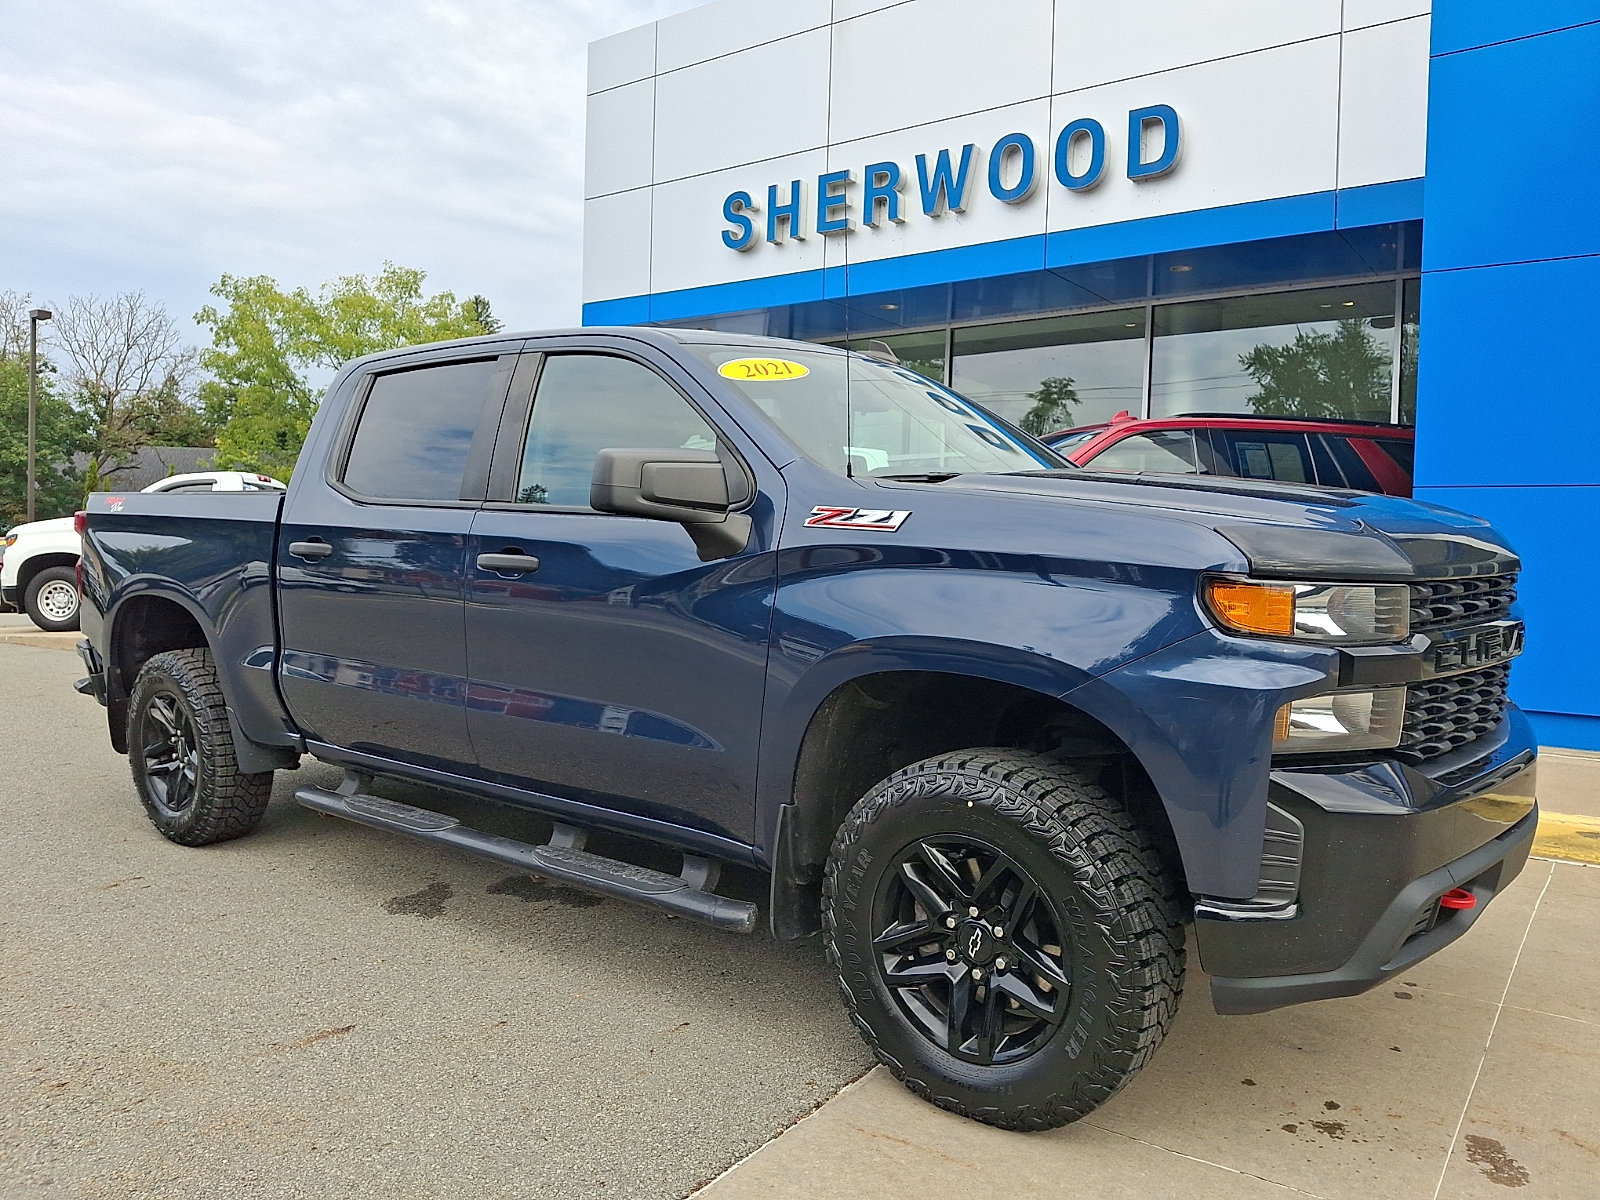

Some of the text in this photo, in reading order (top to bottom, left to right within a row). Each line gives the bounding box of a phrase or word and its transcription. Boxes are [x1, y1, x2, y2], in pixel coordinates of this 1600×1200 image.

[721, 103, 1184, 252] SHERWOOD
[740, 361, 793, 378] 2021
[803, 505, 913, 533] Z71
